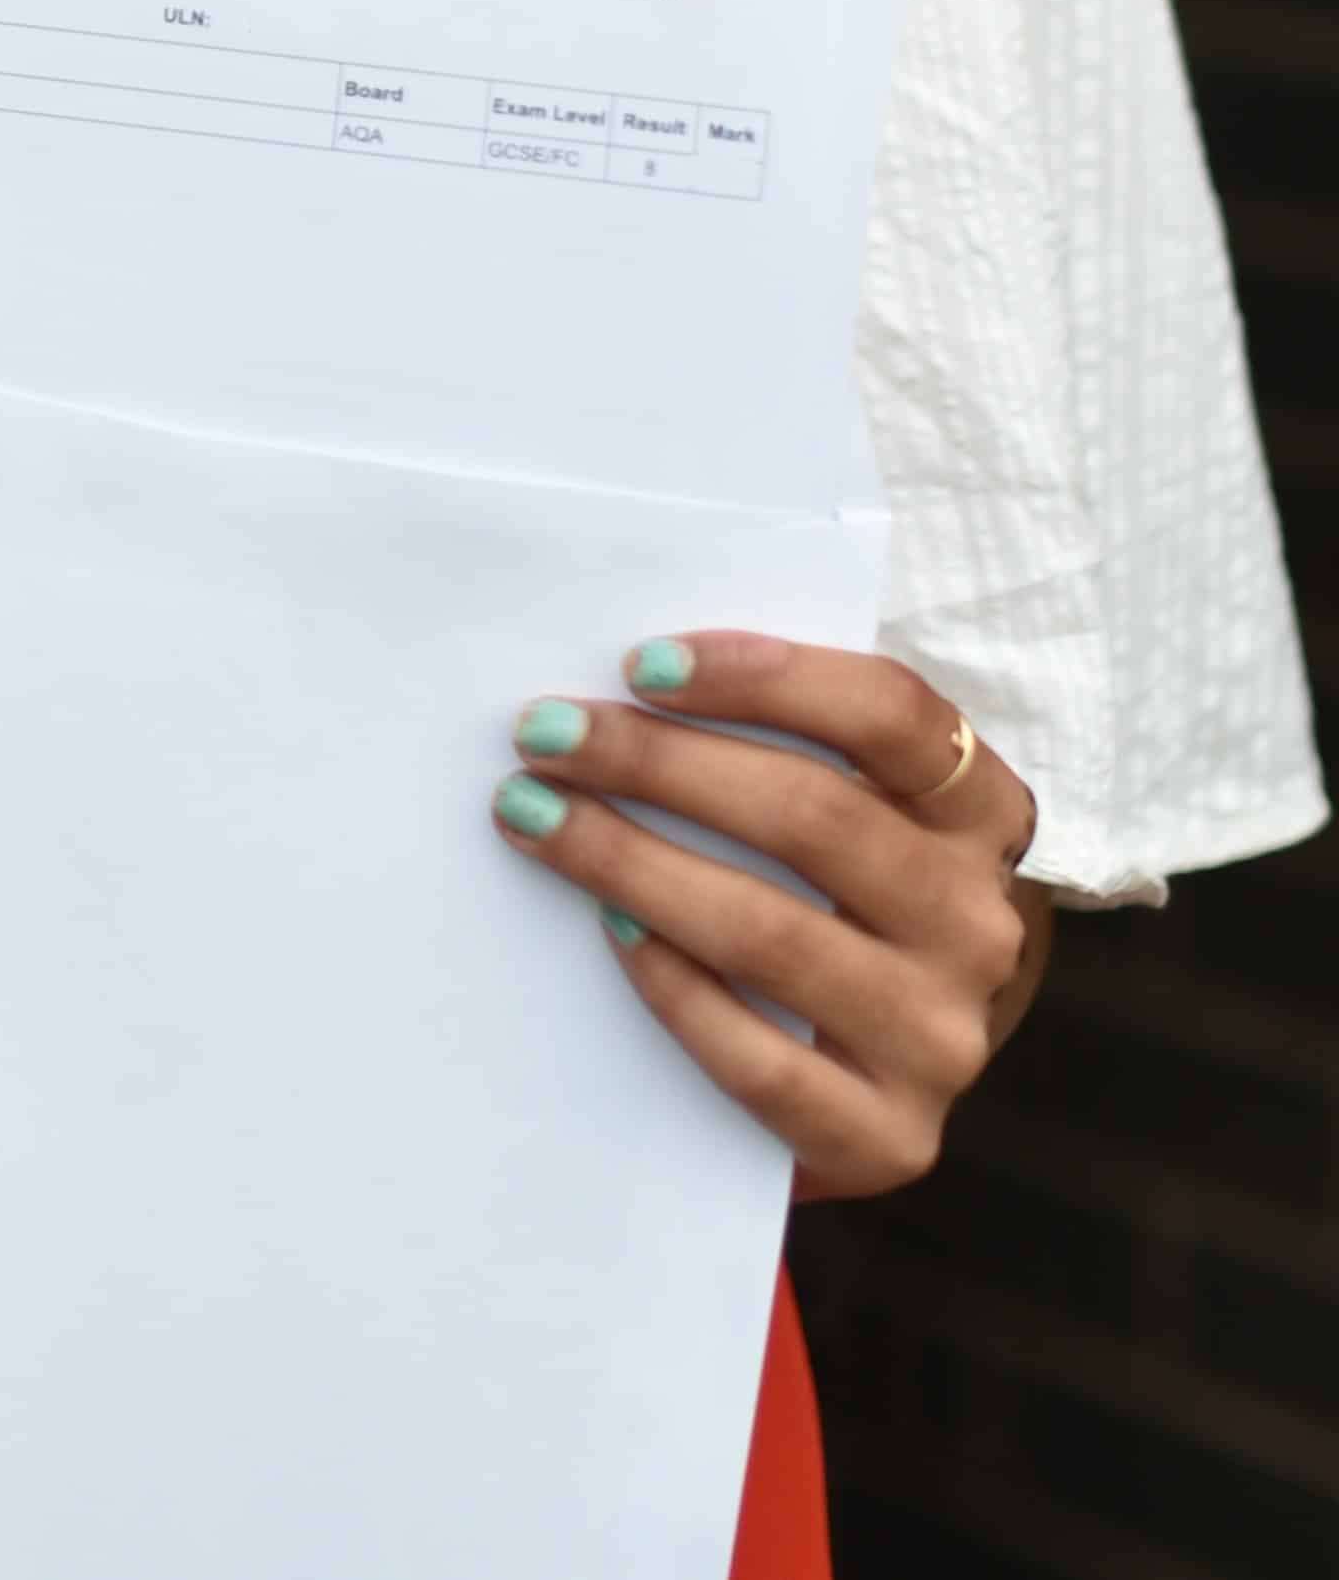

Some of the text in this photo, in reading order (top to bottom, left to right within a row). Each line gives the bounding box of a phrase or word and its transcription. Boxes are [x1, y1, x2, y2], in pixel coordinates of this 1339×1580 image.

[162, 6, 213, 29] ULN:
[343, 81, 404, 105] Board
[492, 97, 548, 120] Exam
[552, 105, 606, 127] Level
[622, 112, 687, 136] Result
[708, 122, 757, 145] Mark
[339, 122, 385, 146] AQA
